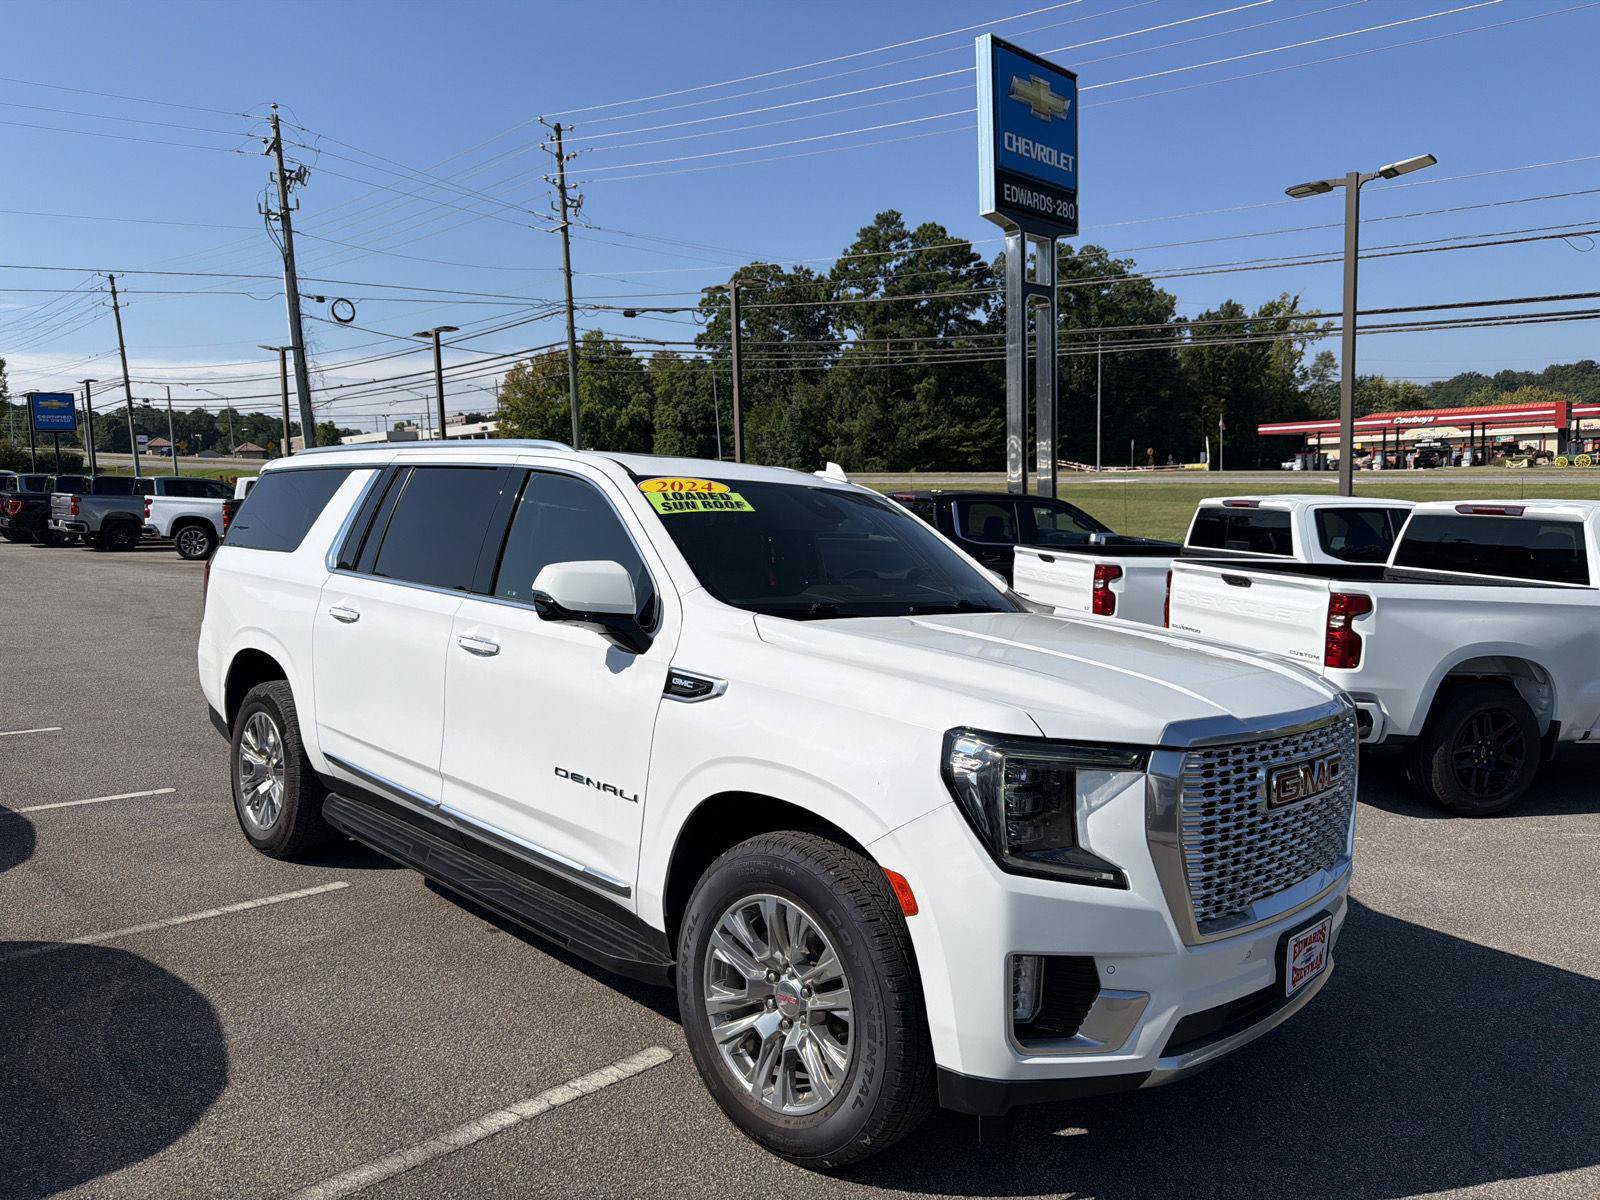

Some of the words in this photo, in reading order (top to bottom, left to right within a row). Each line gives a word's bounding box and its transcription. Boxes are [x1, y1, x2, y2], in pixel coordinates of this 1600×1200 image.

[1004, 132, 1074, 172] CHEVROLET
[1393, 416, 1435, 424] Cowboys
[656, 481, 713, 492] 2024
[663, 492, 731, 501] LOADED
[661, 501, 697, 511] SUN
[703, 500, 746, 510] ROOF
[1176, 591, 1311, 623] CHEVROLET
[1171, 623, 1201, 634] SILVERADO
[1289, 649, 1320, 660] CUSTOM
[672, 678, 694, 688] GMC
[1272, 752, 1342, 803] GMC
[554, 766, 639, 804] DENALI
